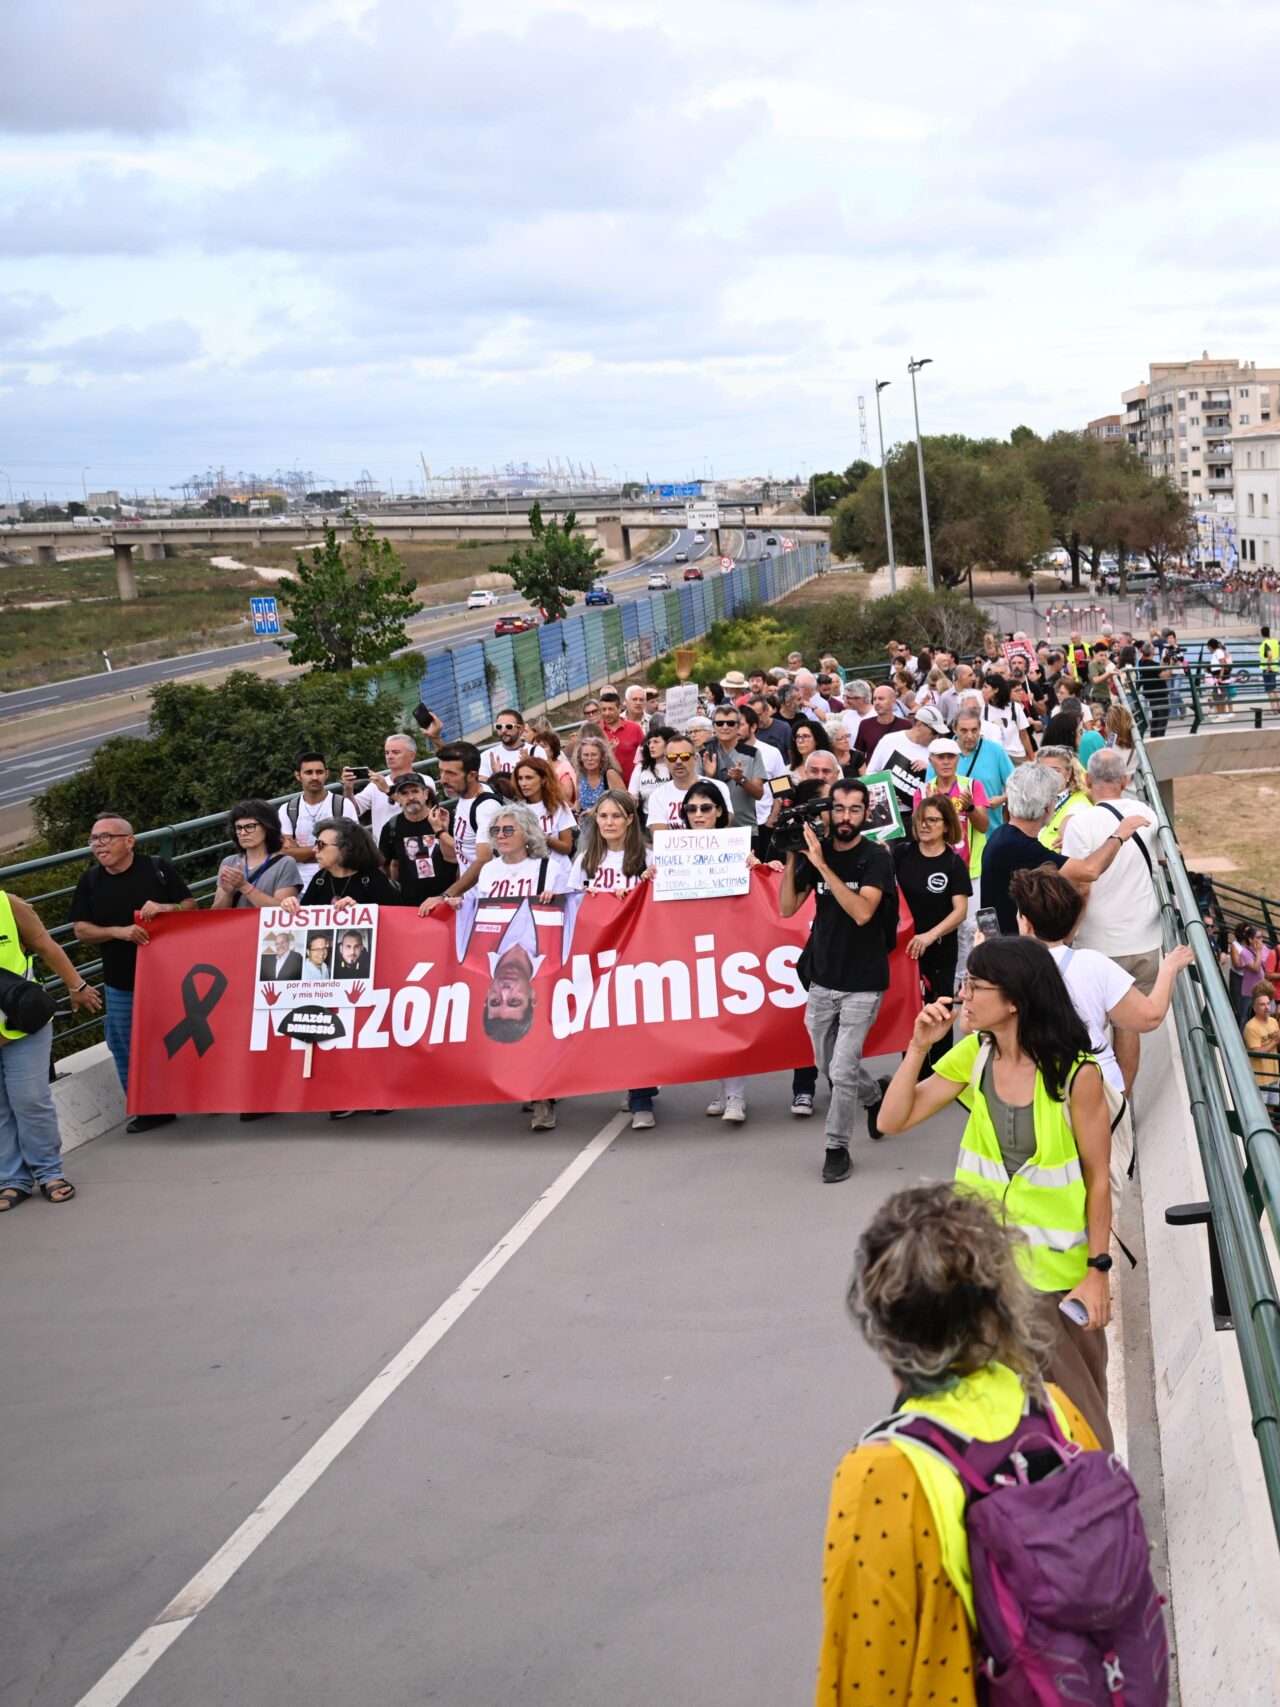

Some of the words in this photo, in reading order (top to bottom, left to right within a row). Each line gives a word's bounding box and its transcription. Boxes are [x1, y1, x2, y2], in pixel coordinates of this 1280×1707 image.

[664, 835, 720, 849] JUSTICIA
[655, 854, 683, 866] MIGUEL
[263, 907, 373, 929] JUSTICIA
[313, 980, 341, 988] marido
[292, 1012, 333, 1024] MAZÓN
[287, 1023, 336, 1035] DIMISSIÓ
